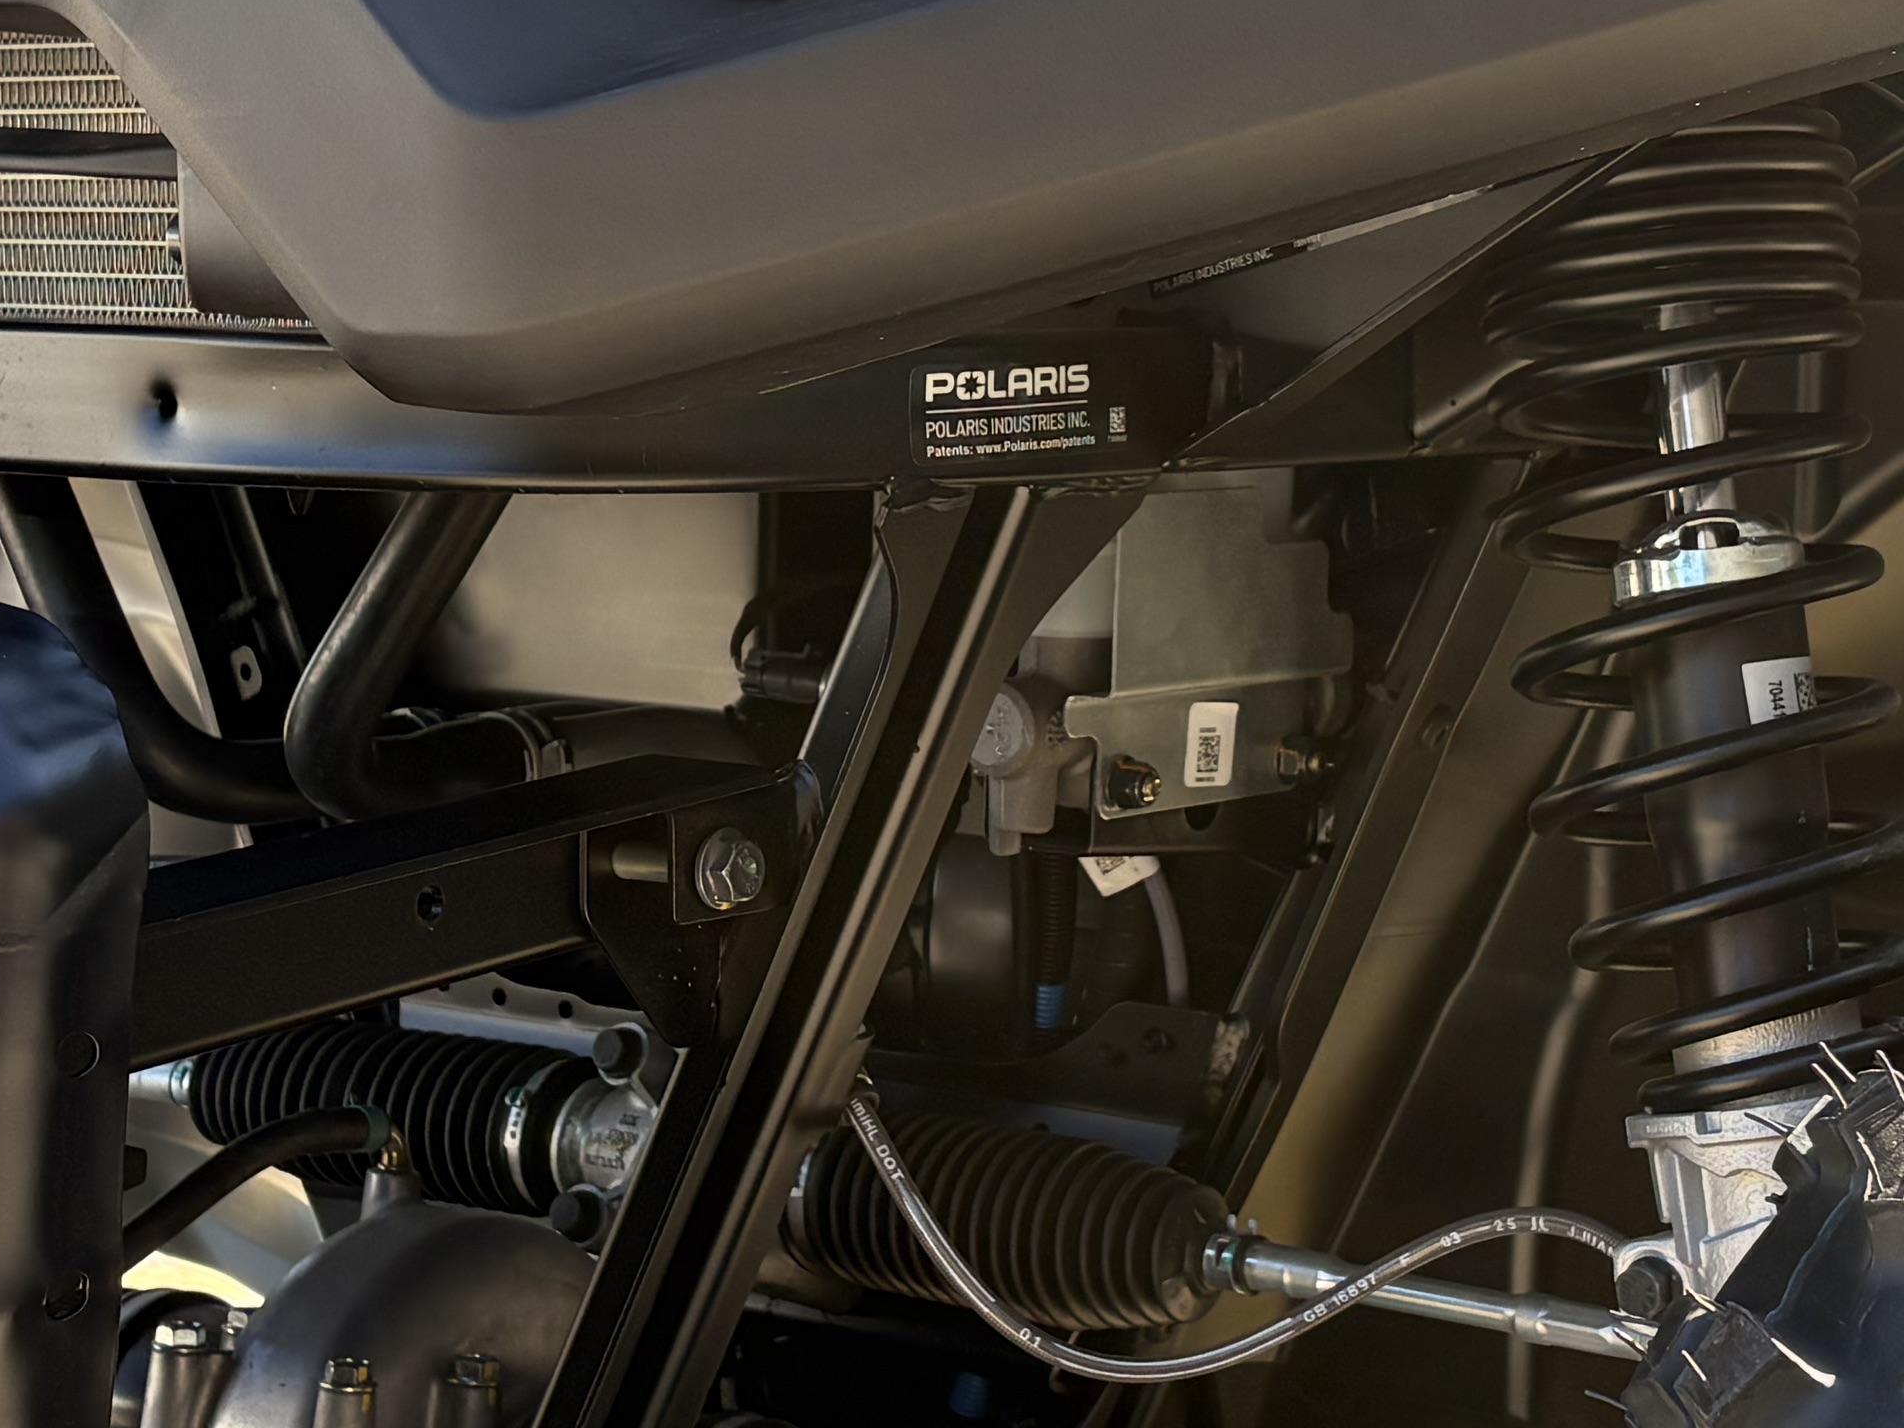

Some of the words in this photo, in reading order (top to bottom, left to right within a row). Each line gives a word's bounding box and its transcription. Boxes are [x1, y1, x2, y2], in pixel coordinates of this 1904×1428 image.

[924, 363, 1091, 403] POLARIS
[924, 417, 988, 439] POLARIS
[990, 412, 1066, 436] INDUSTRIES
[1067, 411, 1091, 429] INC.
[926, 442, 974, 458] Patents:
[976, 433, 1096, 455] www.Polaris.com/patents
[875, 1143, 905, 1180] DOT
[1302, 1302, 1327, 1323] GB
[1331, 1273, 1379, 1307] 16897
[1492, 1216, 1518, 1233] 25
